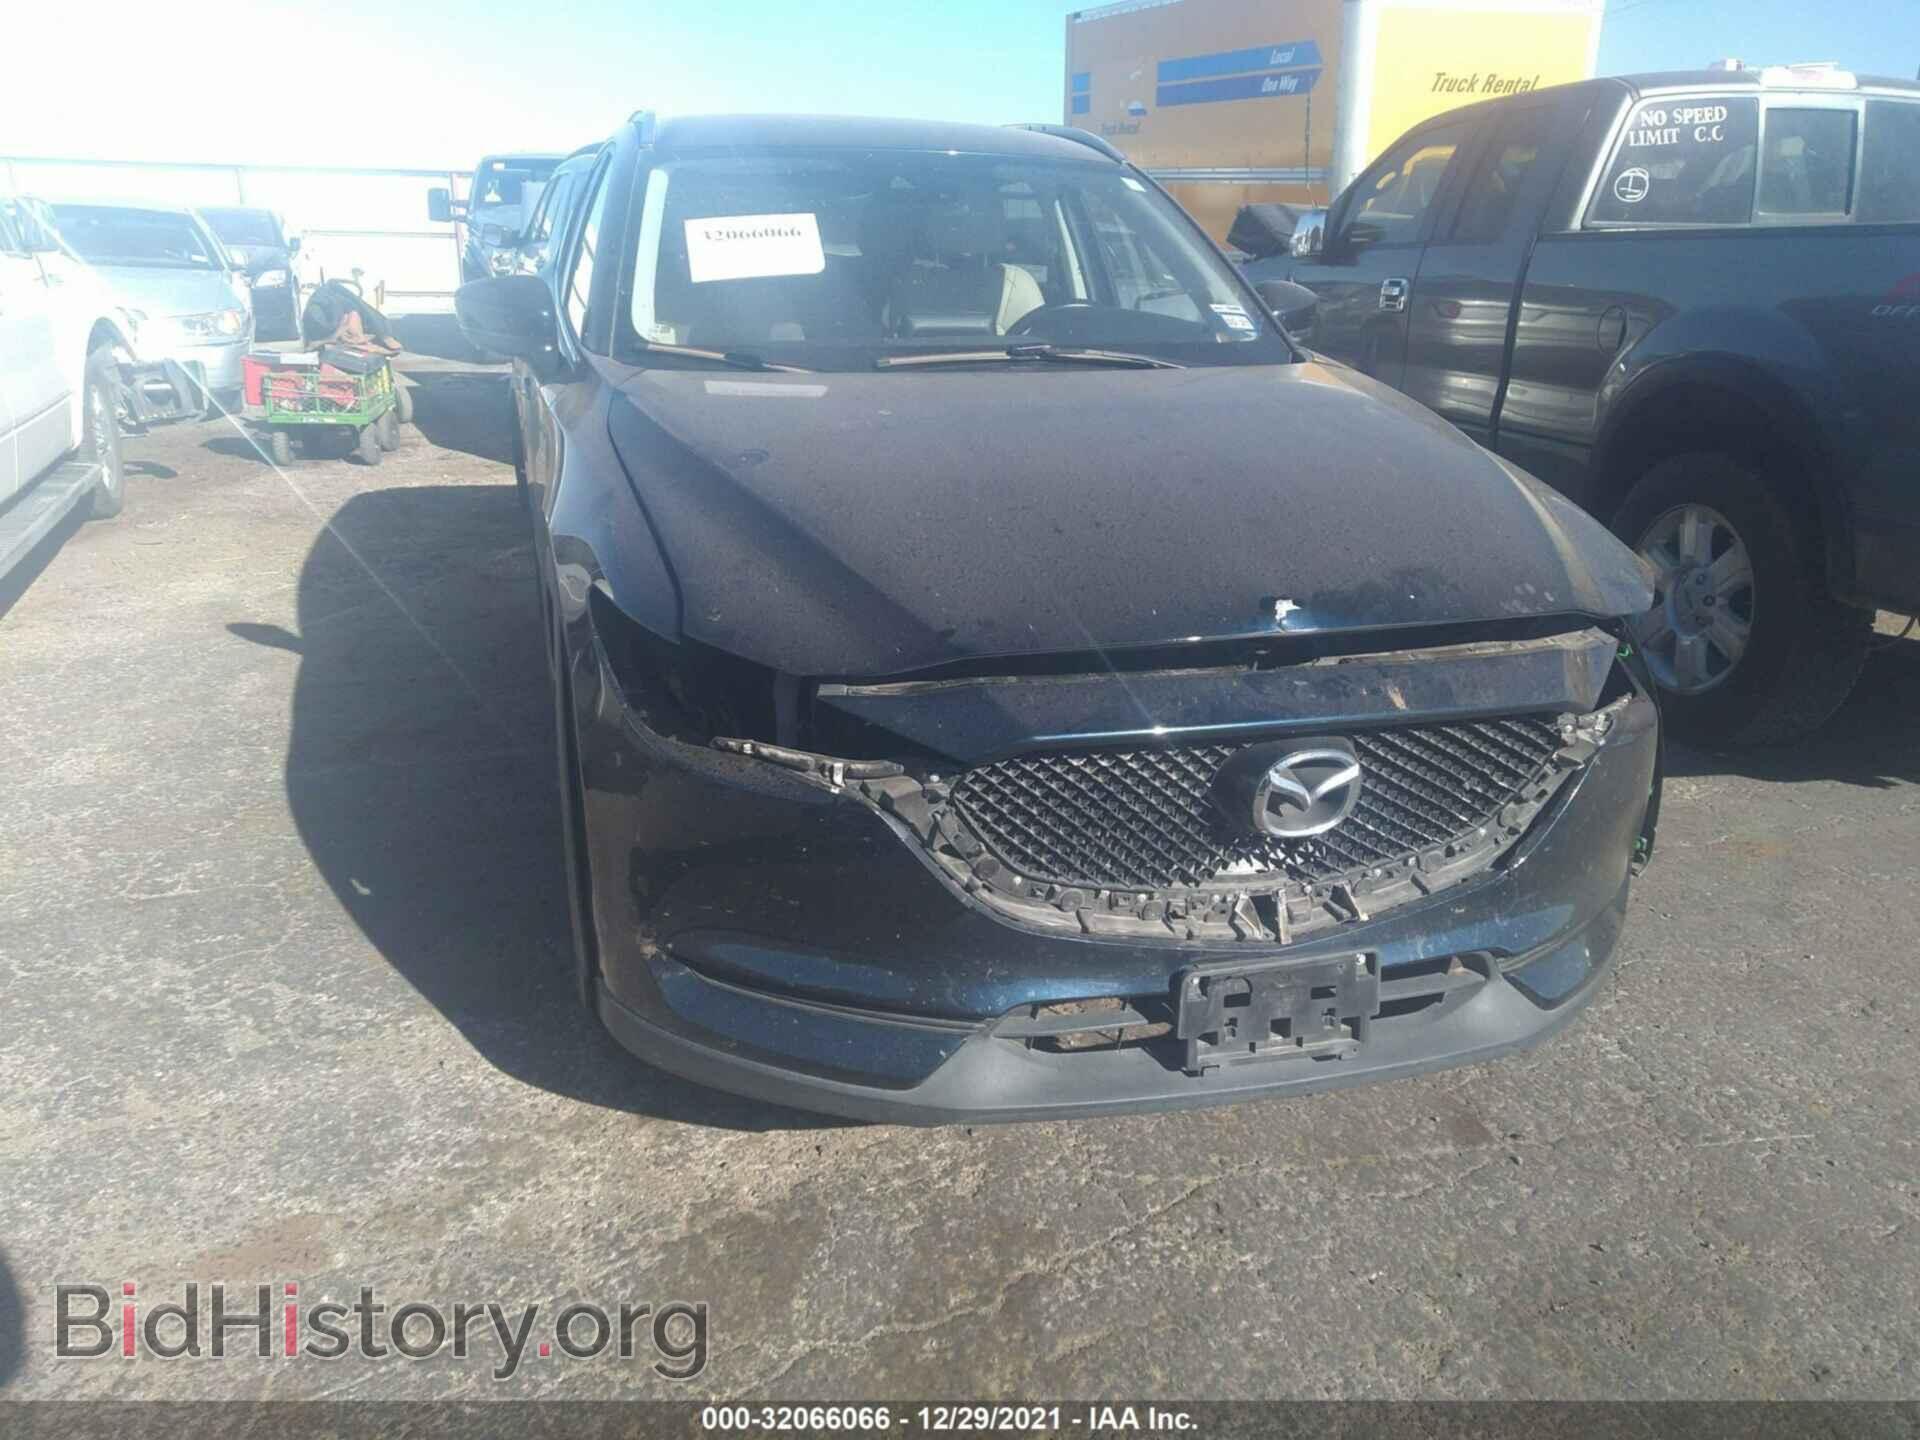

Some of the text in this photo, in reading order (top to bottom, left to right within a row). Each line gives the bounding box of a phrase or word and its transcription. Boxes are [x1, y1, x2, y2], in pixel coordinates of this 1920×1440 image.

[1431, 72, 1541, 94] Truck Rental
[1640, 105, 1728, 127] NO SPEED
[1628, 125, 1725, 146] LIMIT C.C
